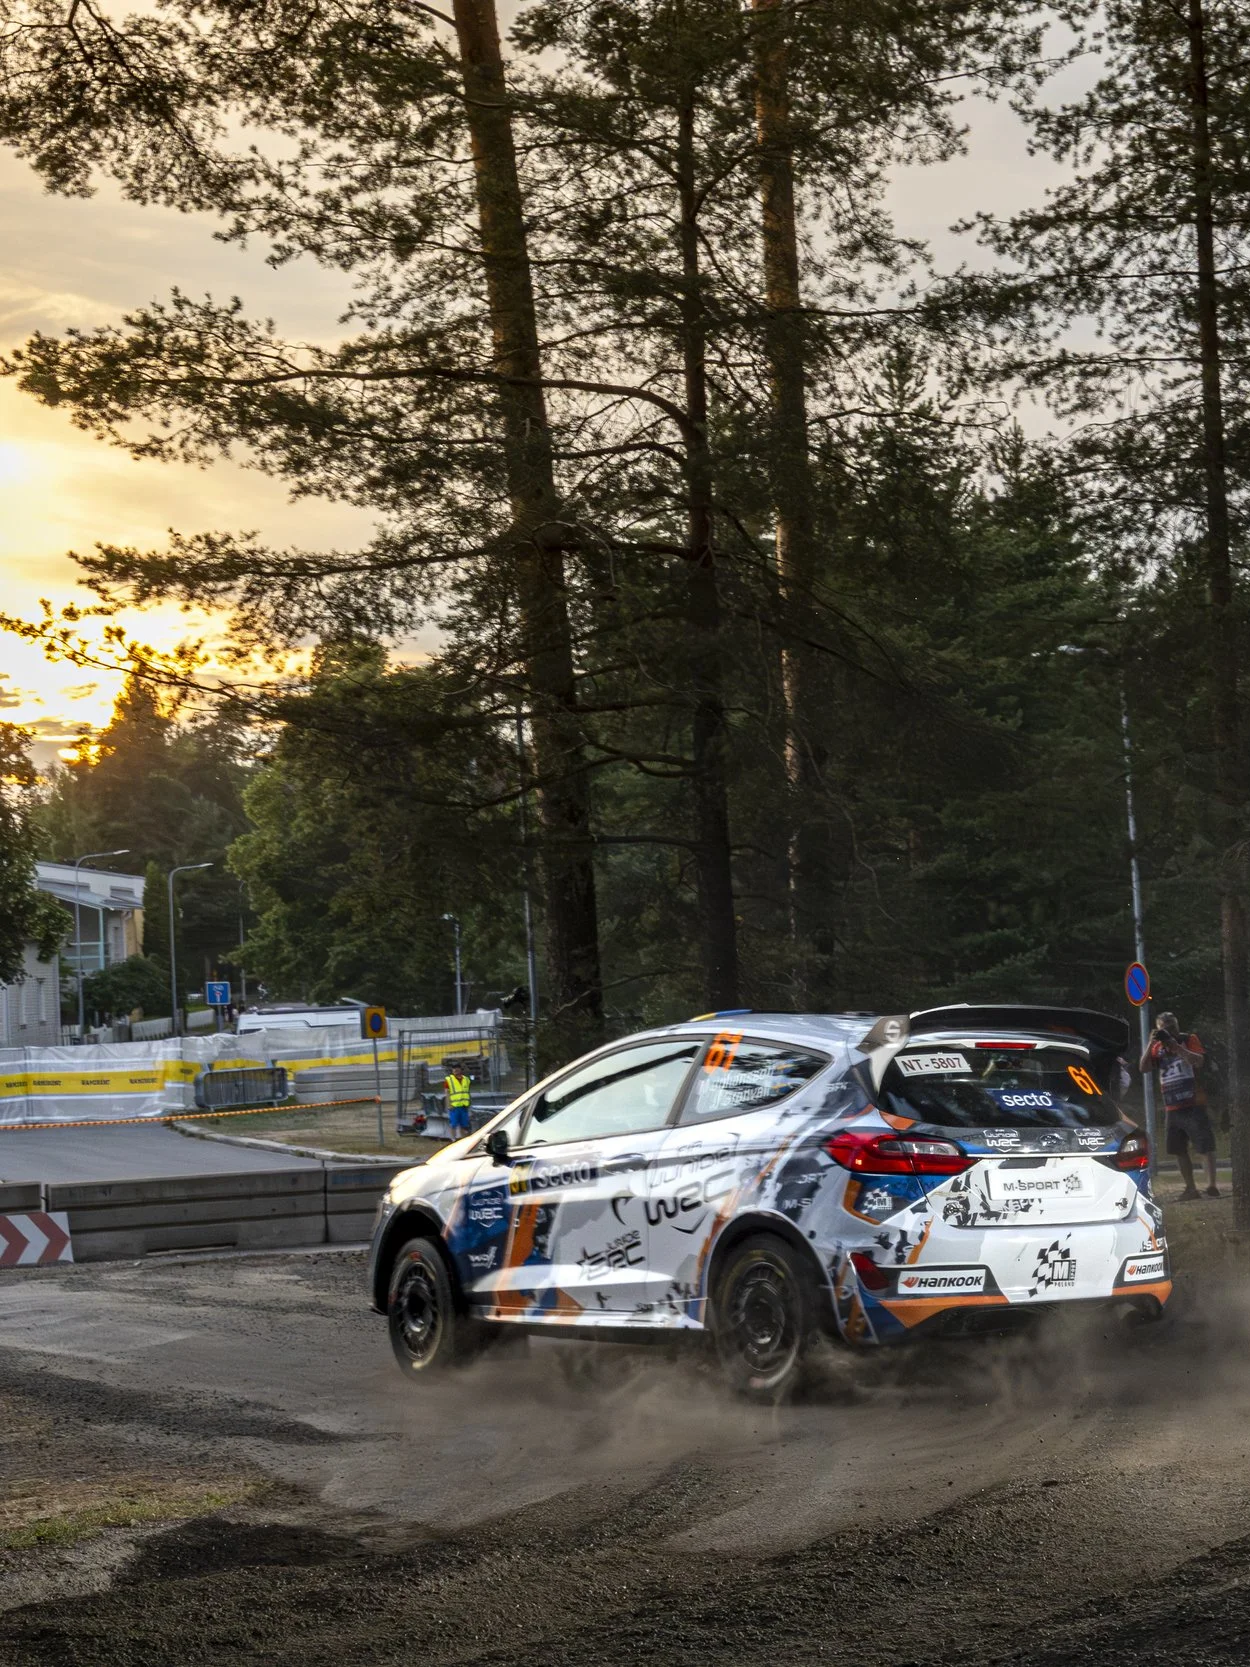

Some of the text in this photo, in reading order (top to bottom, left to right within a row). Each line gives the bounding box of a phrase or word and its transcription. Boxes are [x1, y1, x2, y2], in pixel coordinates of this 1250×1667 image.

[703, 1030, 744, 1075] 61
[901, 1057, 963, 1072] NT-5807
[1067, 1065, 1102, 1095] 61
[1002, 1092, 1053, 1107] secto
[986, 1138, 1022, 1147] WRC
[1078, 1137, 1106, 1146] WRC
[1003, 1180, 1061, 1192] M-SPORT
[644, 1168, 736, 1227] WRC
[918, 1276, 984, 1288] HANKOOK
